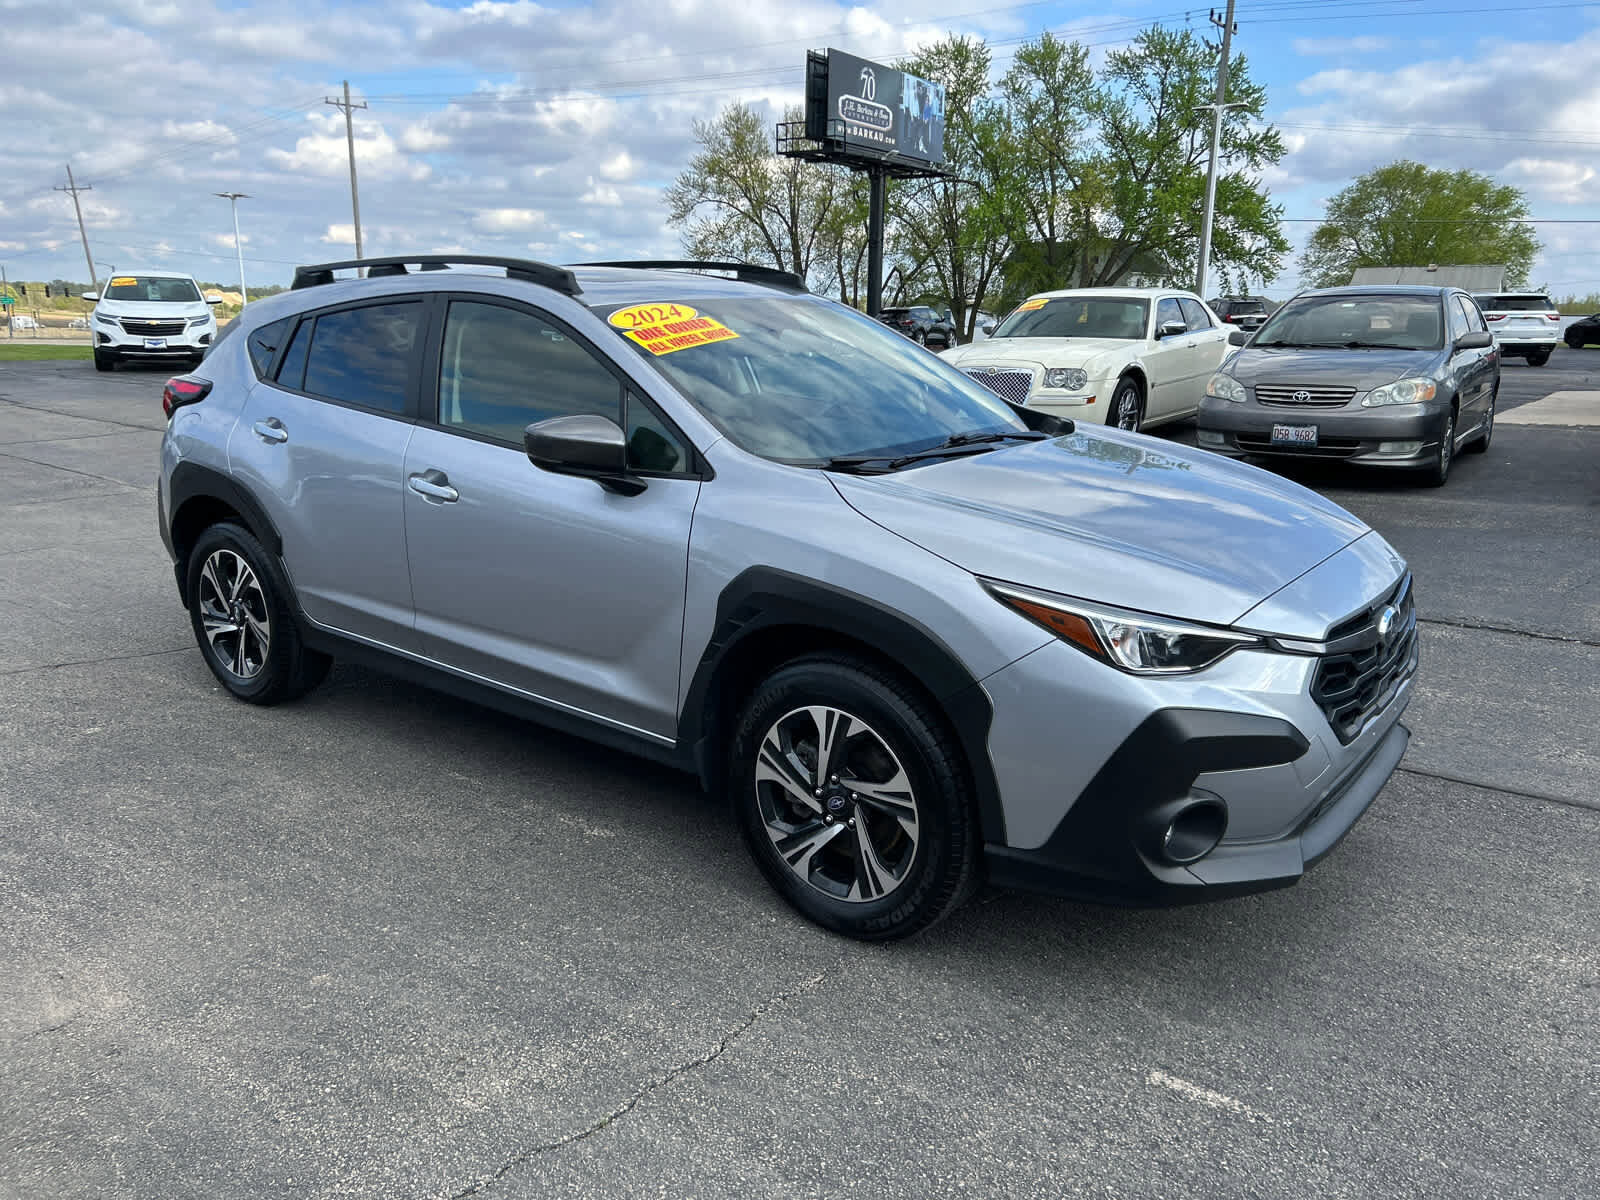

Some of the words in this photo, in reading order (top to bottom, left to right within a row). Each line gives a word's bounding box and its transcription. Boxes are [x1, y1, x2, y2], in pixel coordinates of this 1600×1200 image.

[860, 75, 876, 100] 70
[623, 304, 683, 327] 2024
[633, 326, 667, 341] ONE
[663, 318, 713, 335] OWNER
[646, 340, 673, 353] ALL
[666, 334, 707, 348] WHEEL
[700, 327, 734, 340] DRIVE
